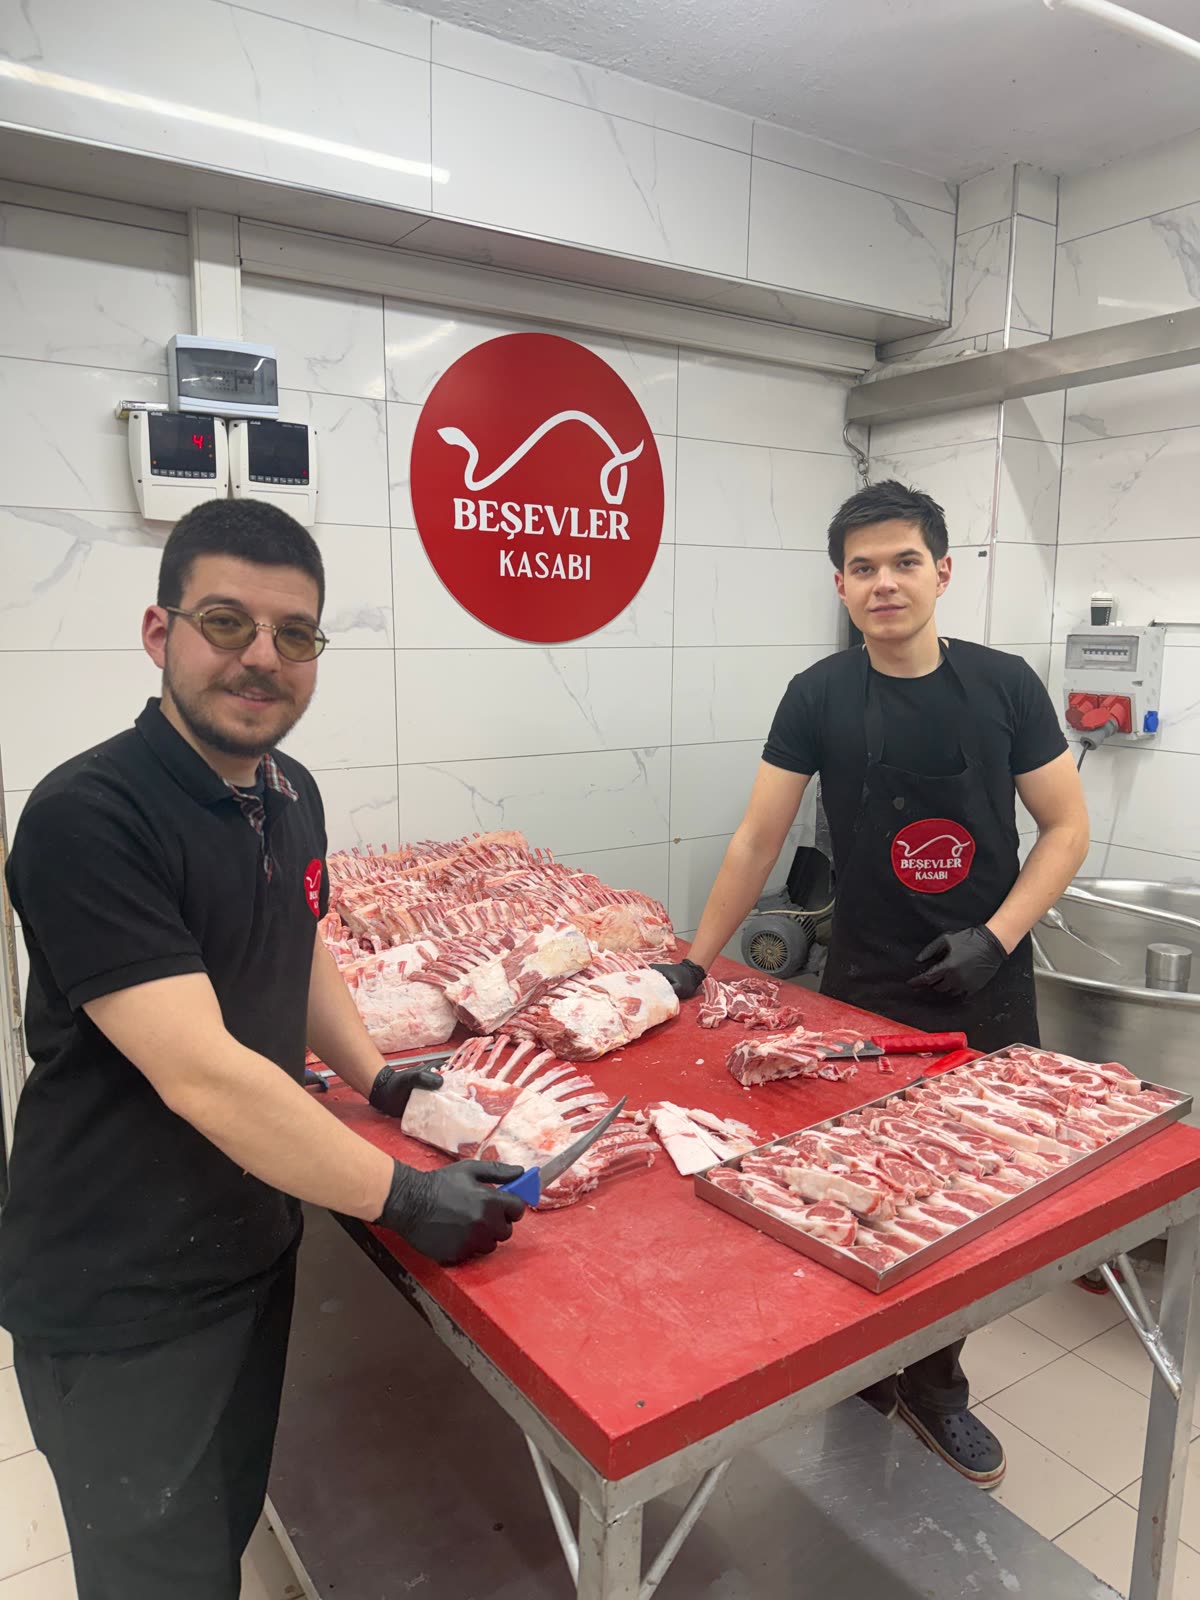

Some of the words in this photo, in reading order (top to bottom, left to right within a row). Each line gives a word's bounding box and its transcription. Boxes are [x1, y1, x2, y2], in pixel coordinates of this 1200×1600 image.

[192, 434, 204, 449] 4
[453, 498, 630, 540] BEŞEVLER
[499, 549, 591, 581] KASABI
[900, 858, 962, 870] BEŞEVLER
[915, 871, 948, 880] KASABI
